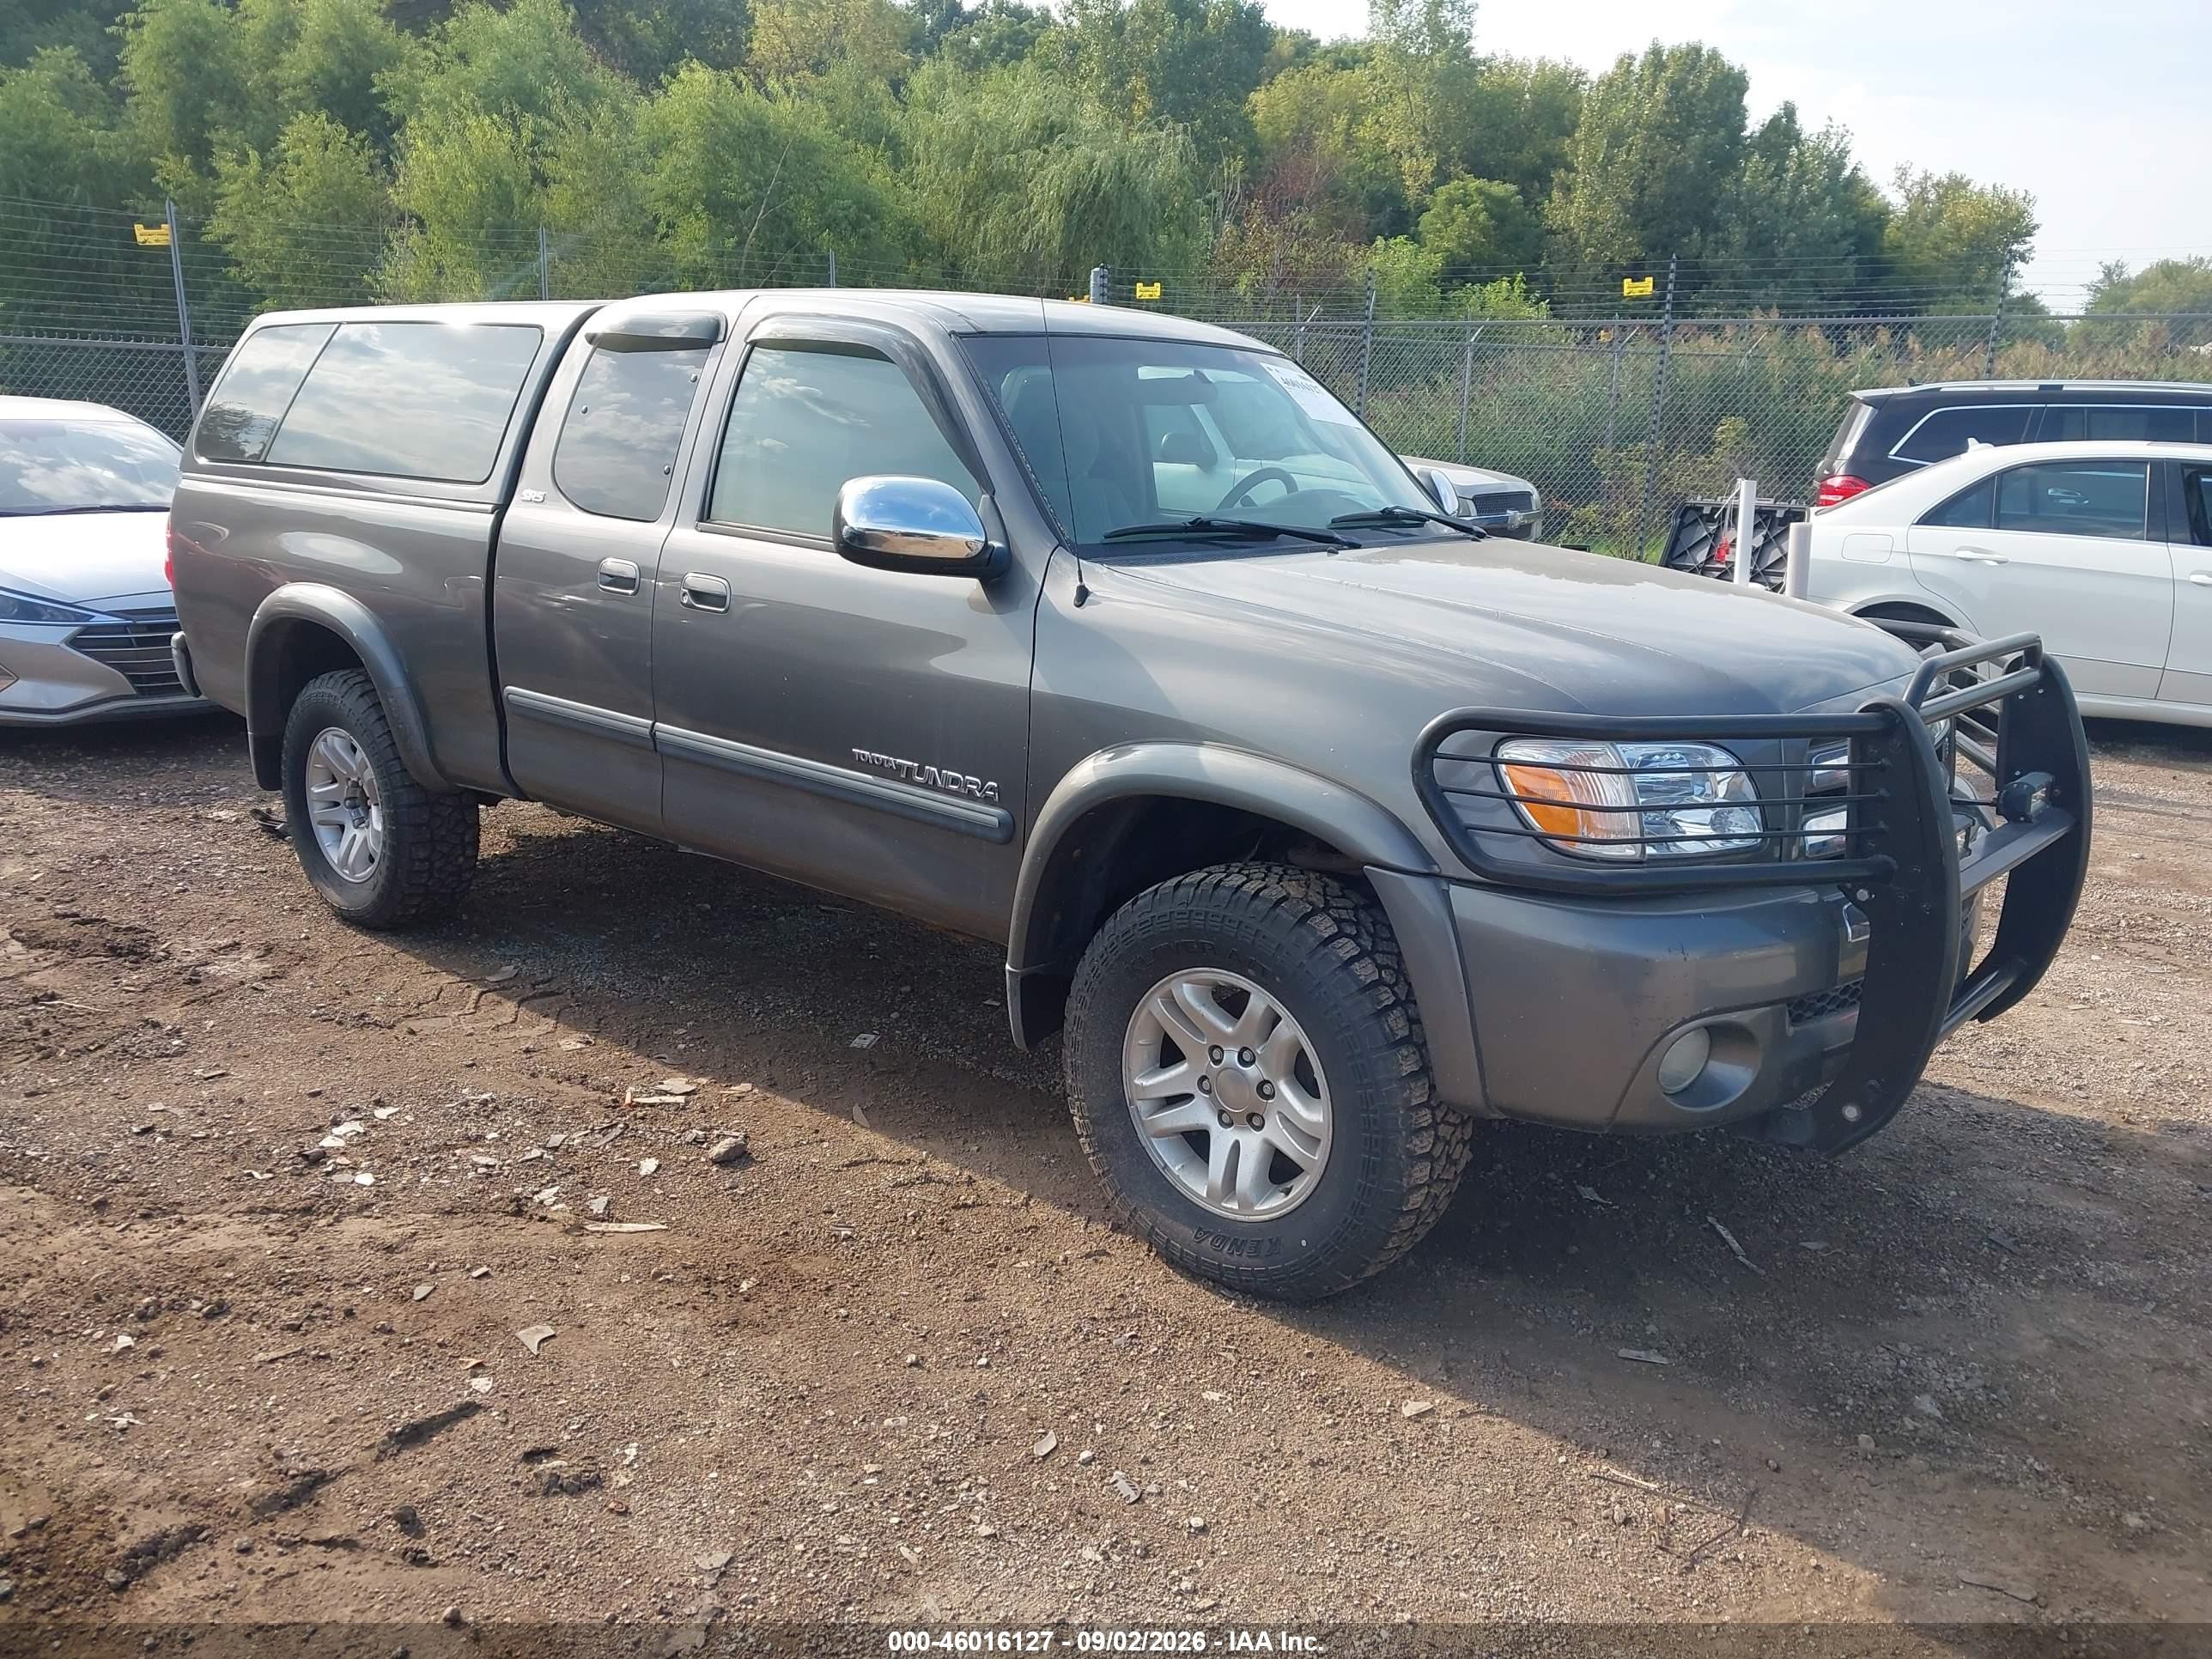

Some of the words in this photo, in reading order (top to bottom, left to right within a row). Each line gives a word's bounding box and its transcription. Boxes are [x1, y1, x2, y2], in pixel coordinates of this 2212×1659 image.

[521, 488, 547, 503] SR5
[852, 748, 896, 770] TOYOTA
[896, 758, 1000, 803] TUNDRA
[1192, 1224, 1281, 1256] KENDA
